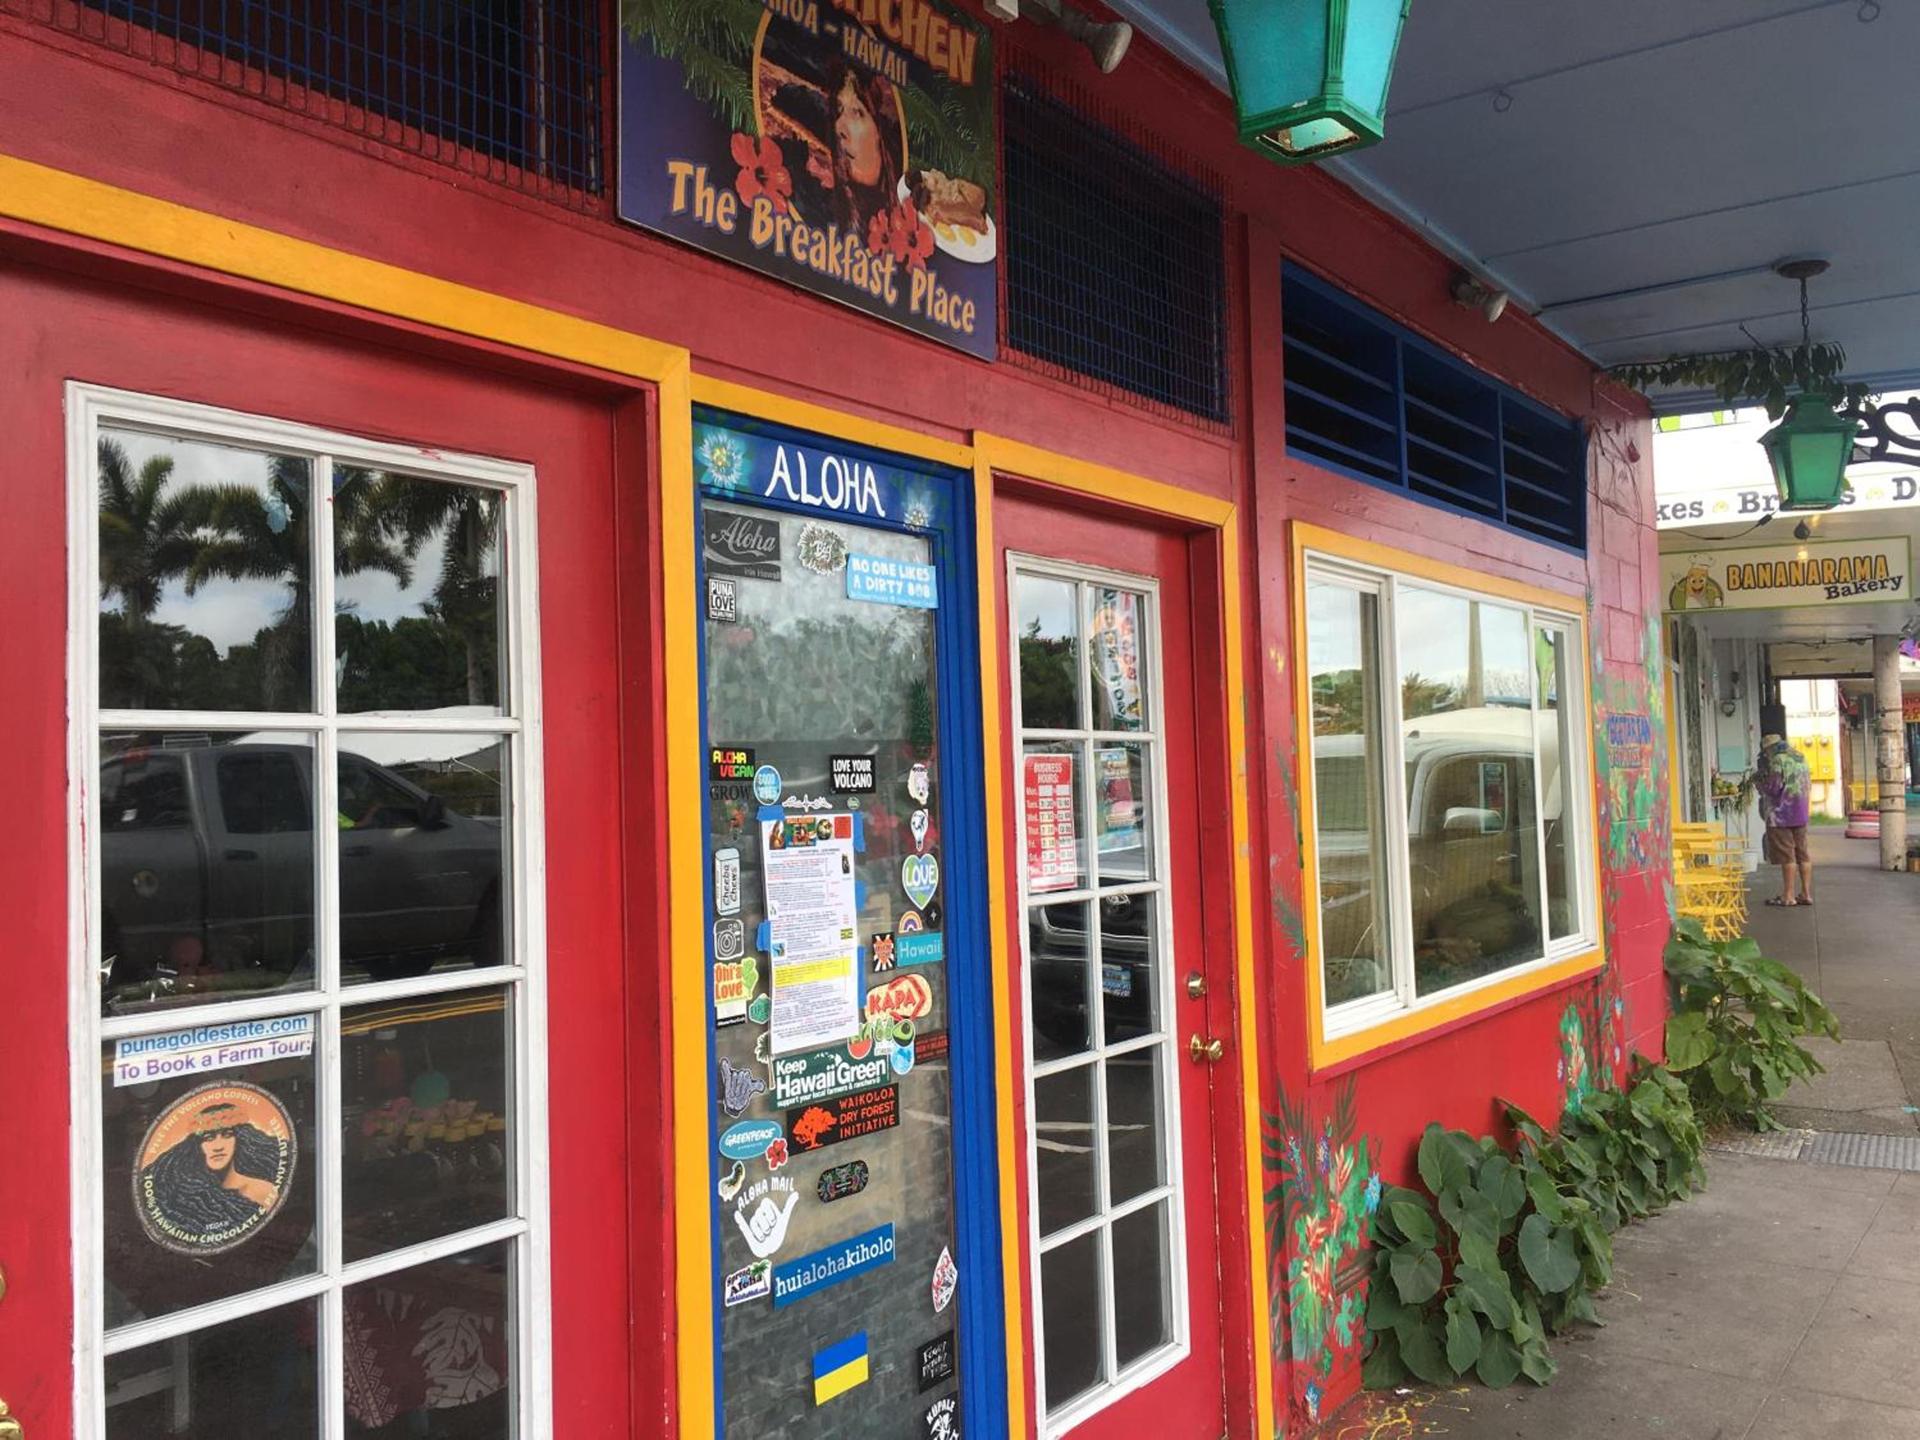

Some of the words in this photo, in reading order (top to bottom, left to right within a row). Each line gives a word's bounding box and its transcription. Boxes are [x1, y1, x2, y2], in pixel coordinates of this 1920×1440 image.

[668, 161, 736, 232] The
[751, 197, 897, 305] Breakfast
[911, 268, 976, 334] Place
[764, 445, 885, 517] ALOHA
[1891, 476, 1920, 501] D
[711, 517, 776, 556] Aloha
[852, 558, 870, 572] NO
[872, 561, 896, 577] ONE
[898, 564, 930, 581] LIKES
[1727, 555, 1890, 591] BANANARAMA
[711, 582, 733, 597] PUNA
[853, 575, 861, 589] A
[866, 576, 904, 594] DIRTY
[1824, 574, 1903, 600] Bakery
[711, 596, 734, 611] LOVE
[713, 750, 747, 764] ALOHA
[833, 760, 850, 772] LOVE
[852, 760, 871, 772] YOUR
[720, 765, 754, 777] VEGAN
[834, 774, 872, 788] VOLCANO
[711, 785, 750, 800] GROW
[730, 867, 738, 902] Chews
[906, 864, 936, 886] LOVE
[900, 941, 941, 959] Hawaii
[715, 983, 743, 1000] Love
[868, 989, 916, 1014] KAPA
[120, 1016, 307, 1058] punagoldestate.com
[118, 1064, 140, 1079] To
[147, 1056, 196, 1076] Book
[201, 1055, 212, 1067] a
[219, 1045, 263, 1064] Farm
[269, 1039, 311, 1055] Tour:
[776, 1060, 807, 1075] Keep
[776, 1065, 835, 1099] Hawaii
[836, 1059, 886, 1085] Green
[777, 1095, 799, 1107] support
[800, 1093, 812, 1103] your
[812, 1088, 826, 1099] local
[827, 1084, 848, 1095] farmers
[839, 1088, 895, 1110] WAIKOLOA
[840, 1111, 859, 1125] DRY
[861, 1101, 895, 1118] FOREST
[725, 1128, 776, 1147] GREENPEACE
[840, 1114, 896, 1138] INITIATIVE
[143, 1174, 158, 1209] 100%
[263, 1160, 288, 1206] PEANUT
[738, 1179, 768, 1211] ALOHA
[771, 1176, 794, 1192] MAIL
[150, 1206, 199, 1243] HAWAIIAN
[199, 1213, 261, 1244] CHOCOLATE
[776, 1237, 893, 1298] huialohakiholo
[731, 1275, 763, 1296] Aloha
